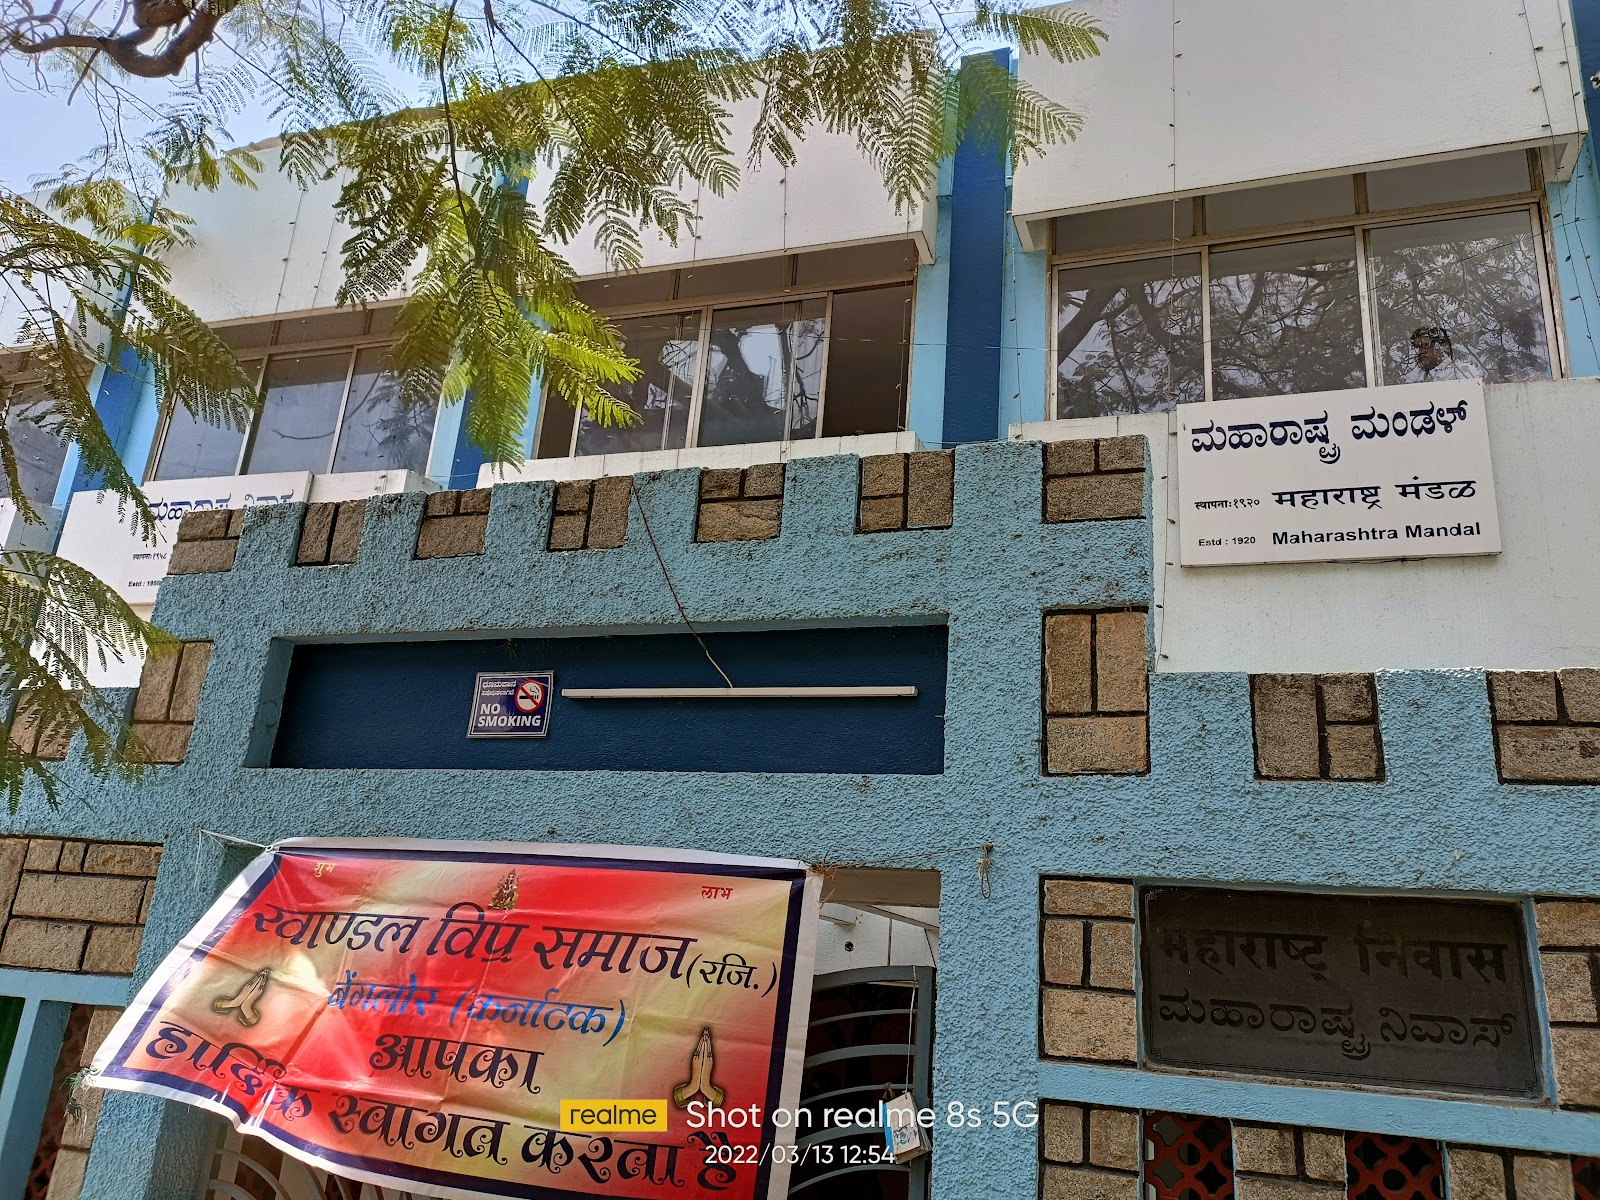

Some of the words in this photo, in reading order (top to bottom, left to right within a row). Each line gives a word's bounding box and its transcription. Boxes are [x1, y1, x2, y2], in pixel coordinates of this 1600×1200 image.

[1191, 410, 1342, 464] ಮಹಾರಾಷ್ಟ್ರ
[1350, 399, 1468, 440] ಮಂಡಳ್
[1271, 486, 1383, 510] महाराष्ट्र
[1394, 475, 1477, 500] मंडळ
[1198, 538, 1222, 546] Estd
[1231, 536, 1256, 545] 1920
[1272, 527, 1399, 546] Maharashtra
[1405, 522, 1481, 540] Mandal
[477, 715, 541, 727] SMOKING
[480, 703, 500, 714] NO
[314, 862, 336, 878] शुभ
[701, 885, 733, 900] लाभ
[426, 901, 530, 963] विप्र
[533, 925, 698, 980] समाज
[1157, 927, 1328, 982] महाराष्ट्र
[1353, 925, 1508, 984] निवास
[449, 985, 627, 1047] (कर्नाटक)
[1158, 988, 1372, 1060] ಮಹಾರಾಷ್ಟ್ರ
[1378, 1006, 1518, 1048] ನಿವಾಸ್
[369, 1032, 545, 1094] आपका
[327, 1091, 510, 1165] स्वागत
